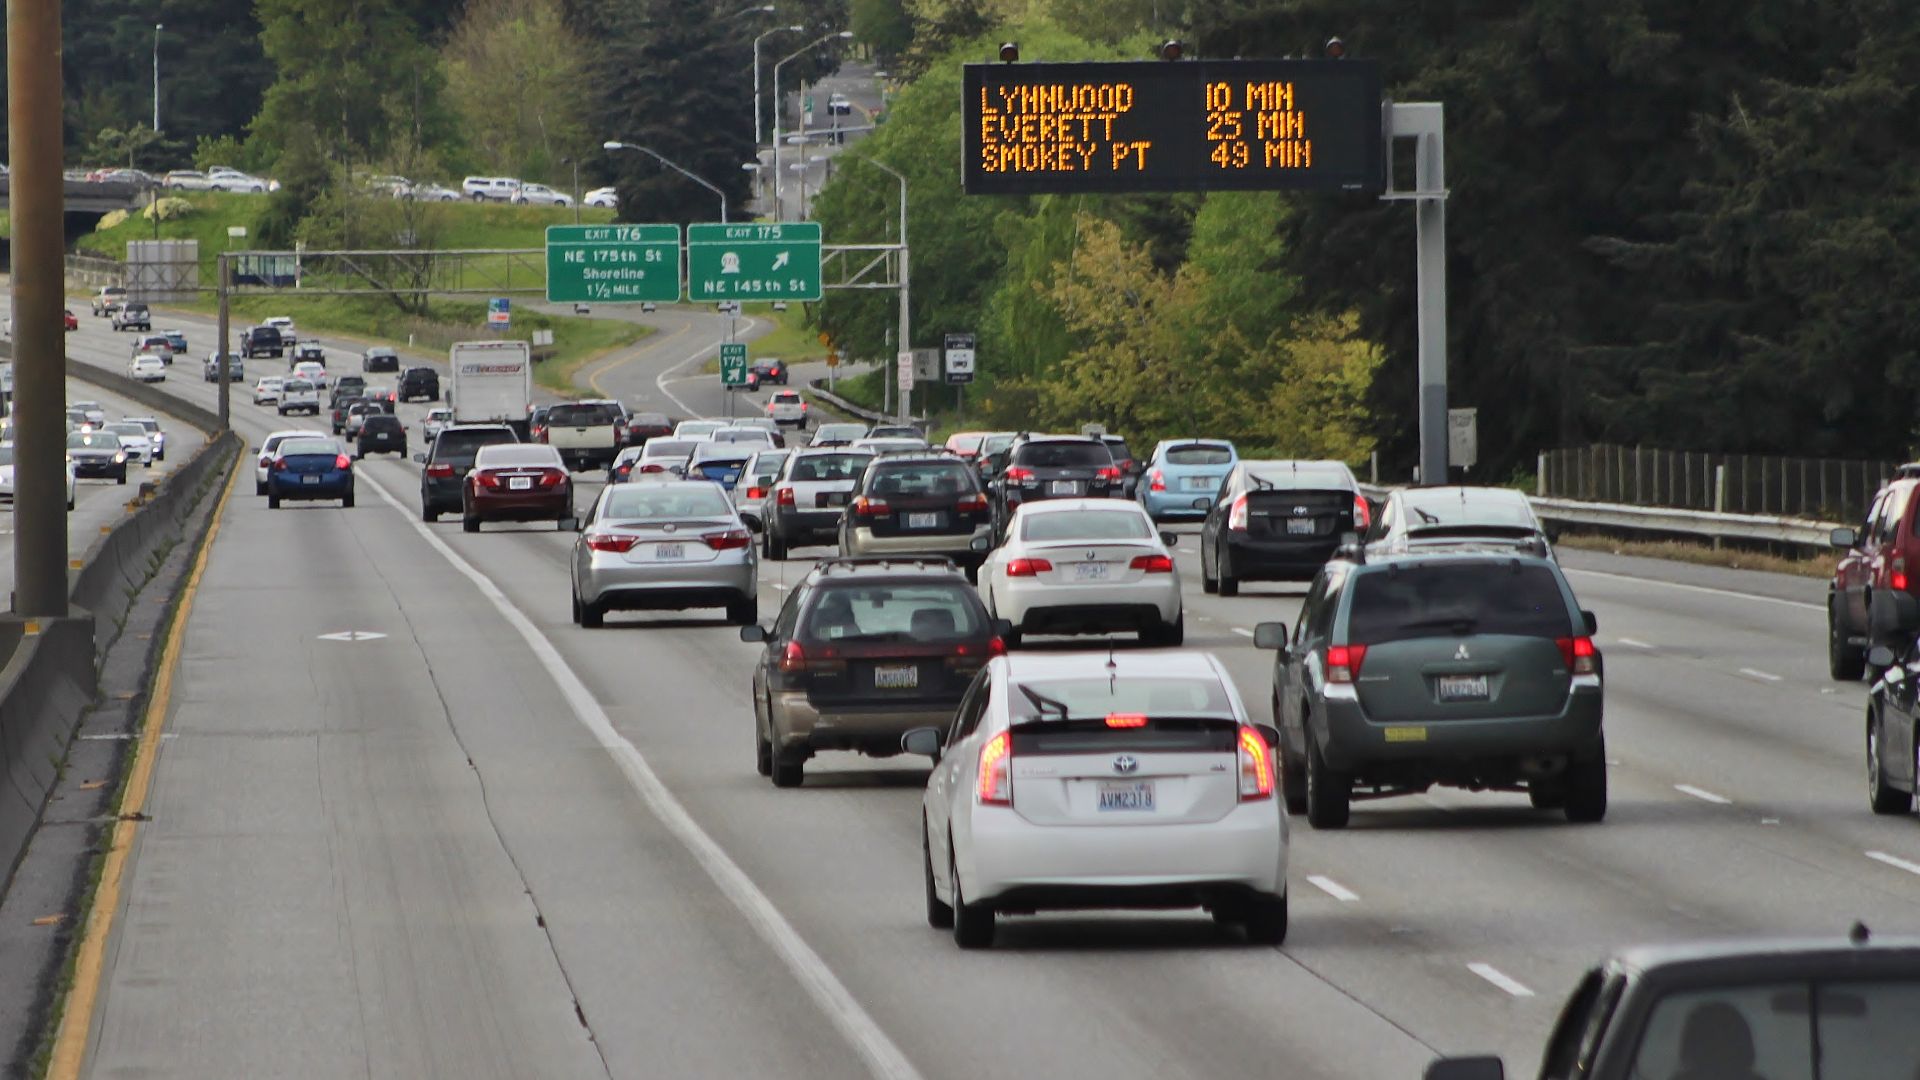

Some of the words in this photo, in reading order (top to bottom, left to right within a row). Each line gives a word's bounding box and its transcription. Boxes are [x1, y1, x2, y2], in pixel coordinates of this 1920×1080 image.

[981, 83, 1134, 114] LYNNWOOD
[1206, 82, 1232, 112] 10
[1246, 81, 1294, 111] MIN
[981, 113, 1119, 143] EVERETT
[1206, 111, 1242, 141] 25
[1257, 111, 1305, 140] MIN
[981, 142, 1097, 172] SMOKEY
[1112, 140, 1152, 171] PT
[1211, 140, 1249, 169] 49
[1265, 139, 1312, 168] MIN
[584, 229, 610, 240] EXIT
[616, 228, 641, 241] 176
[726, 227, 752, 239] EXIT
[757, 226, 782, 239] 175
[564, 250, 586, 263] NE
[593, 249, 638, 263] 175th
[645, 248, 662, 262] St
[582, 268, 645, 280] Shoreline
[613, 285, 640, 296] MILE
[704, 280, 726, 293] NE
[734, 279, 781, 293] 145th
[789, 279, 806, 292] St
[723, 356, 744, 367] 175
